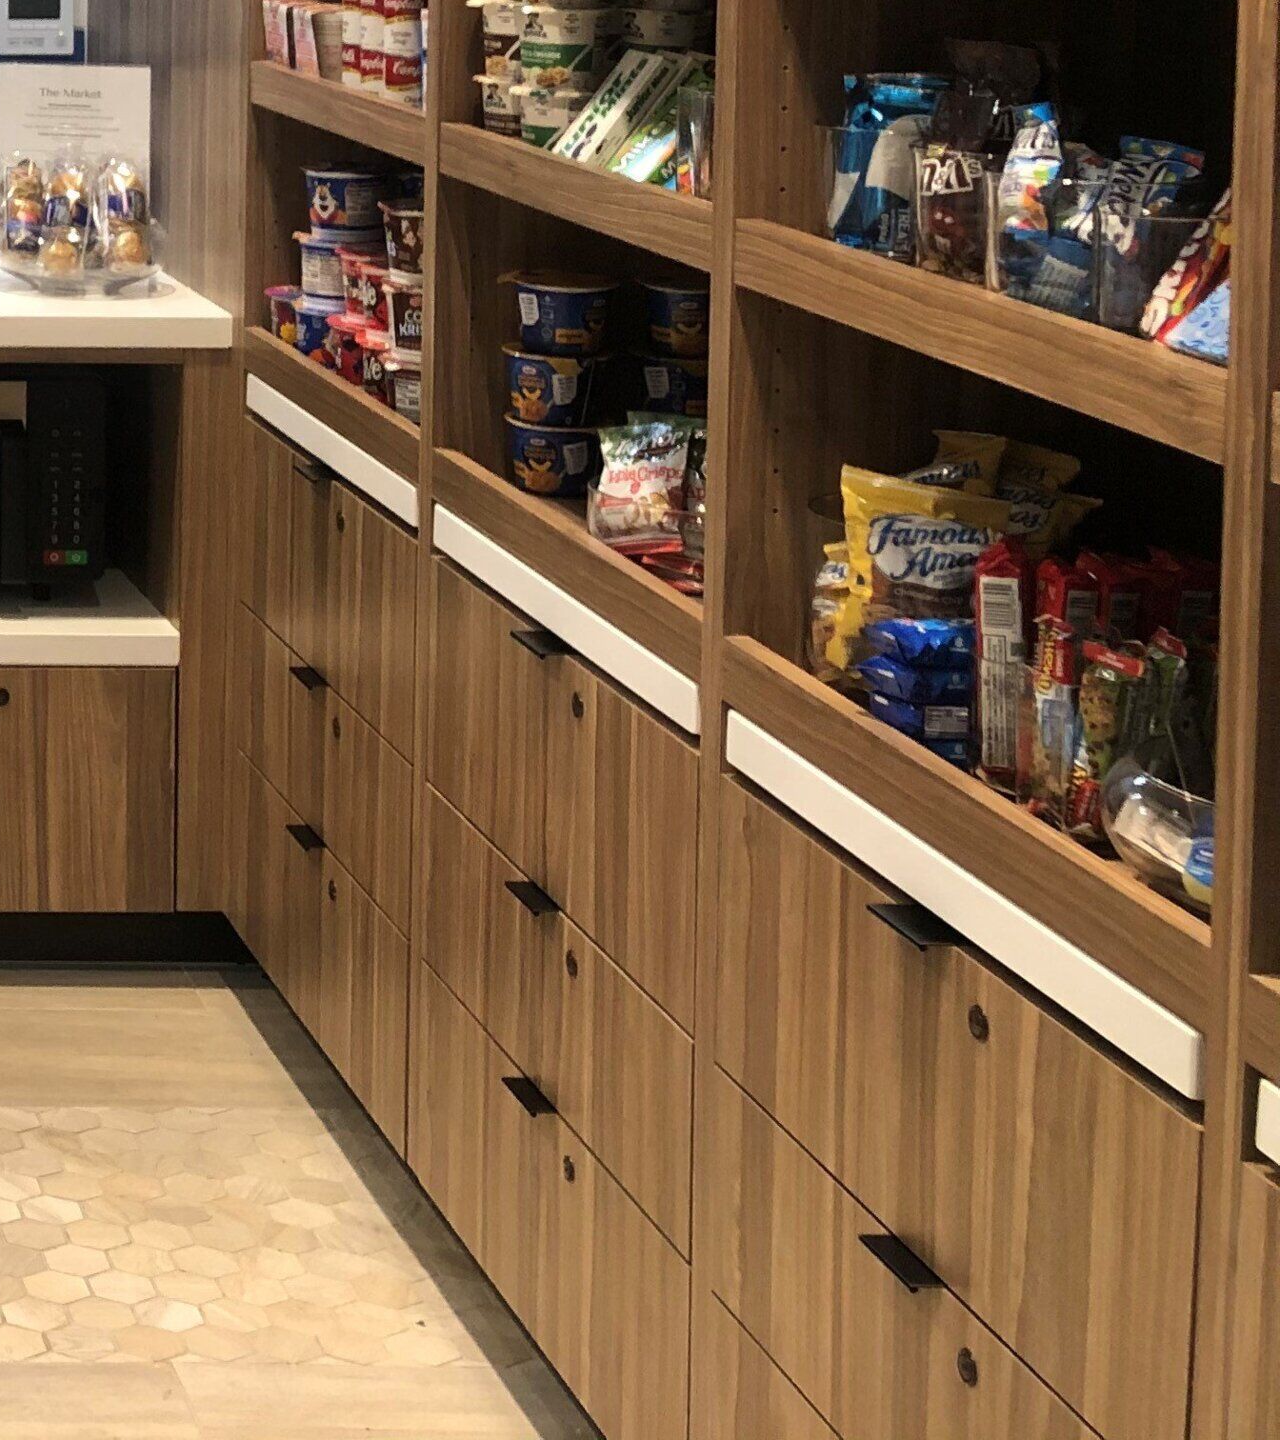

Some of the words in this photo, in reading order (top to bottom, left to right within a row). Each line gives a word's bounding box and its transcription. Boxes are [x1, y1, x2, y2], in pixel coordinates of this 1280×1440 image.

[39, 87, 60, 97] The
[63, 88, 102, 99] Market
[867, 514, 990, 555] Famous
